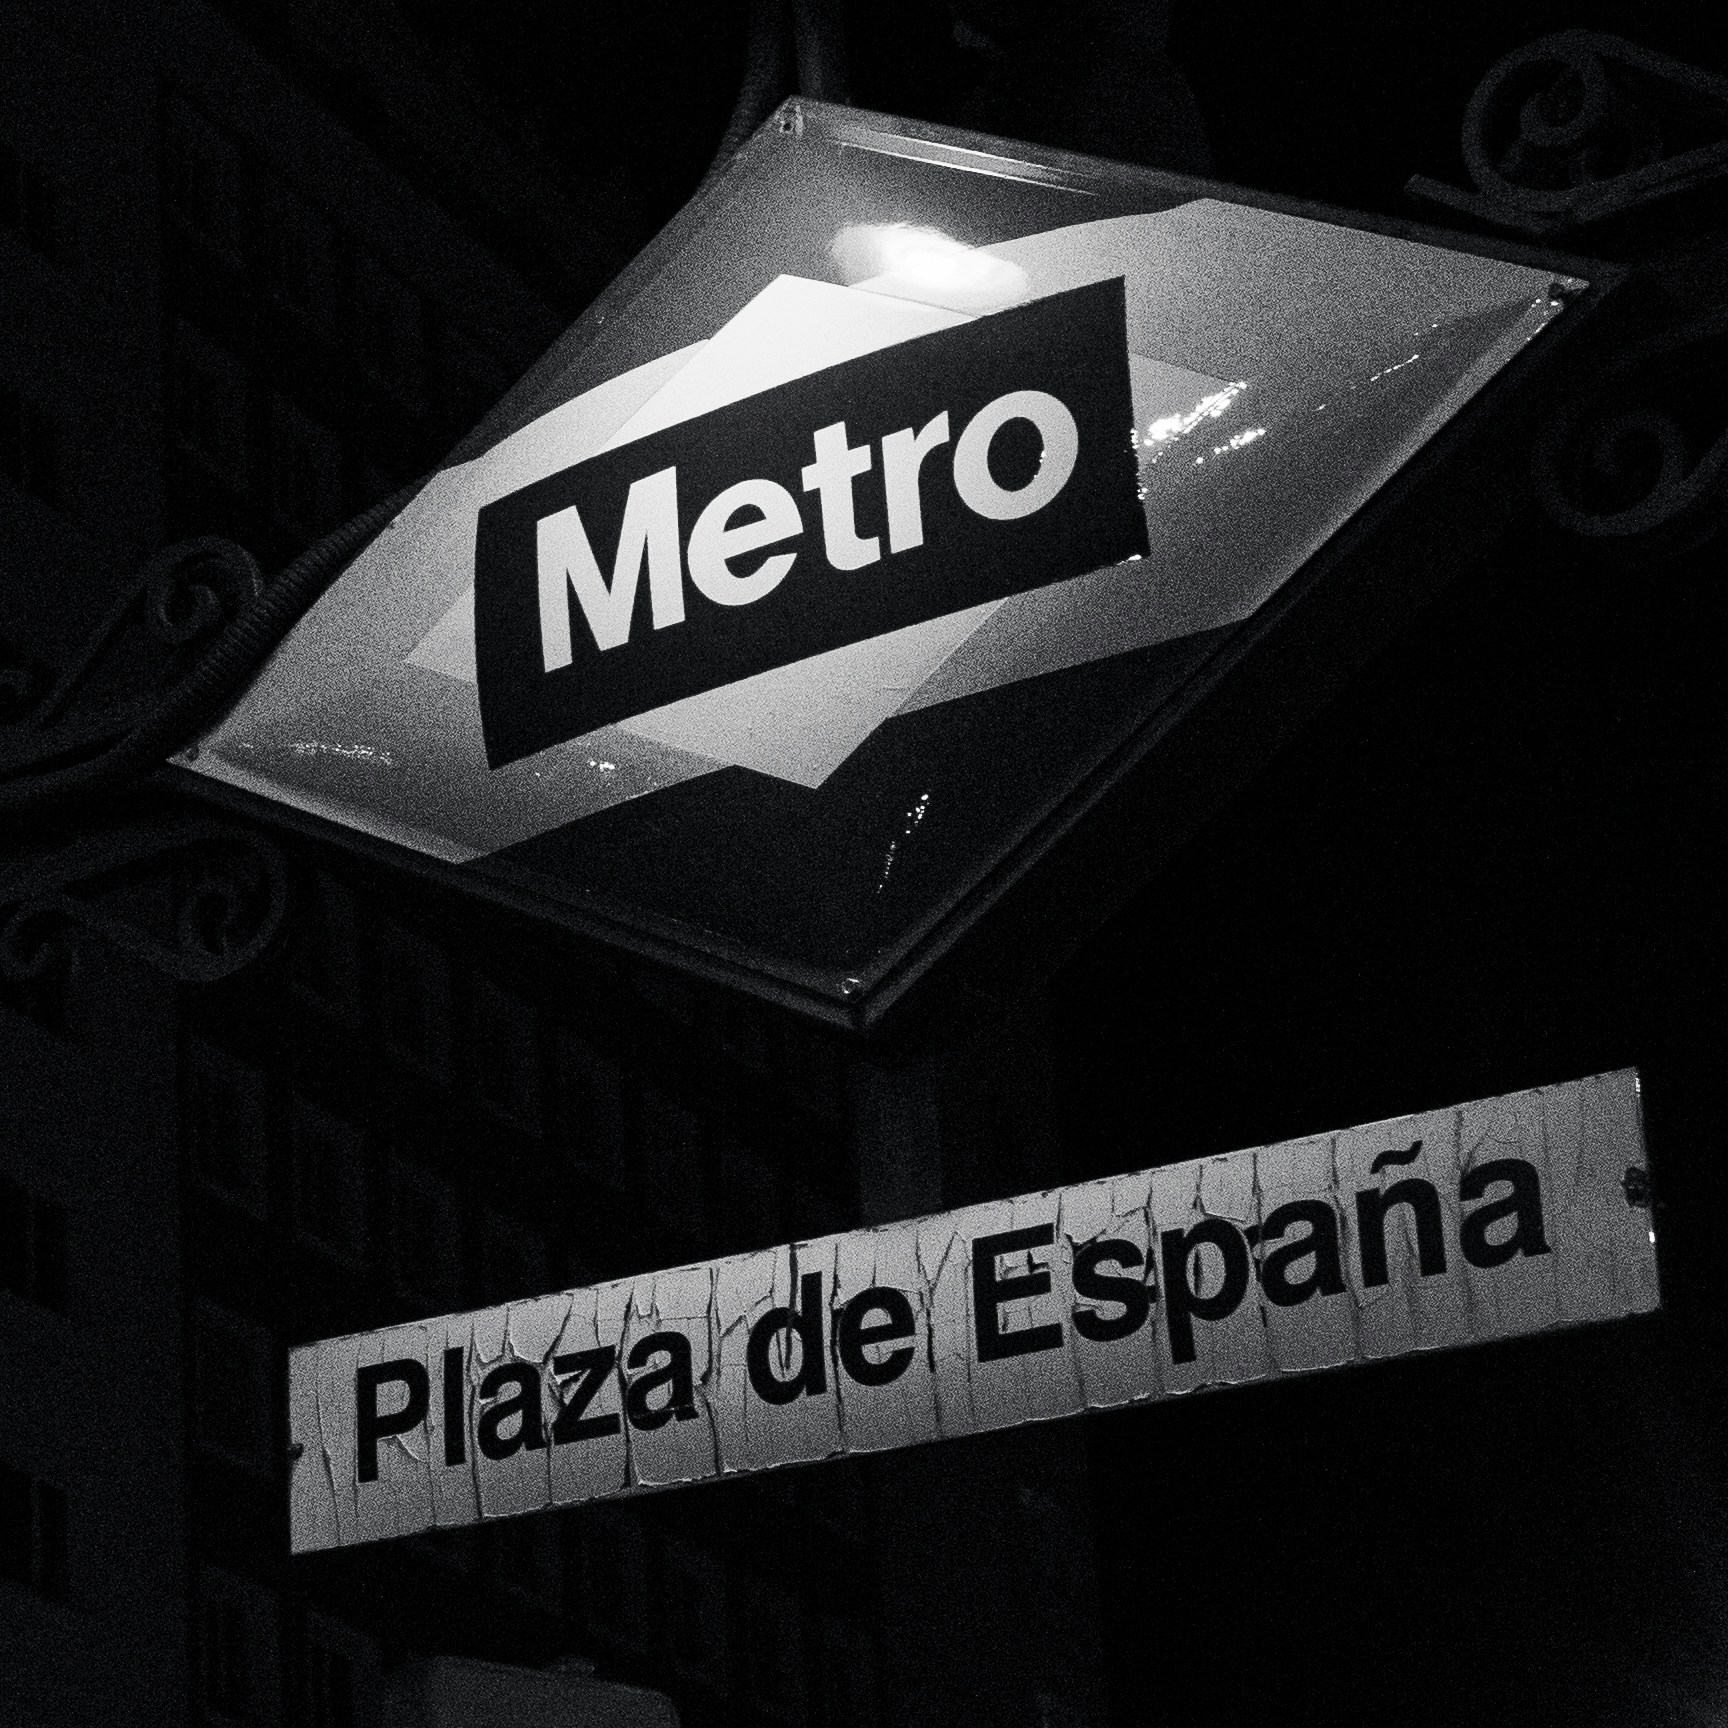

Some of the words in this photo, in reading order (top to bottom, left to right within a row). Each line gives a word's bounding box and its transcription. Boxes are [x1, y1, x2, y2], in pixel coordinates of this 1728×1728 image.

[532, 388, 1080, 676] Metro
[353, 1328, 699, 1484] Plaza
[744, 1270, 920, 1408] de
[970, 1138, 1552, 1365] España
